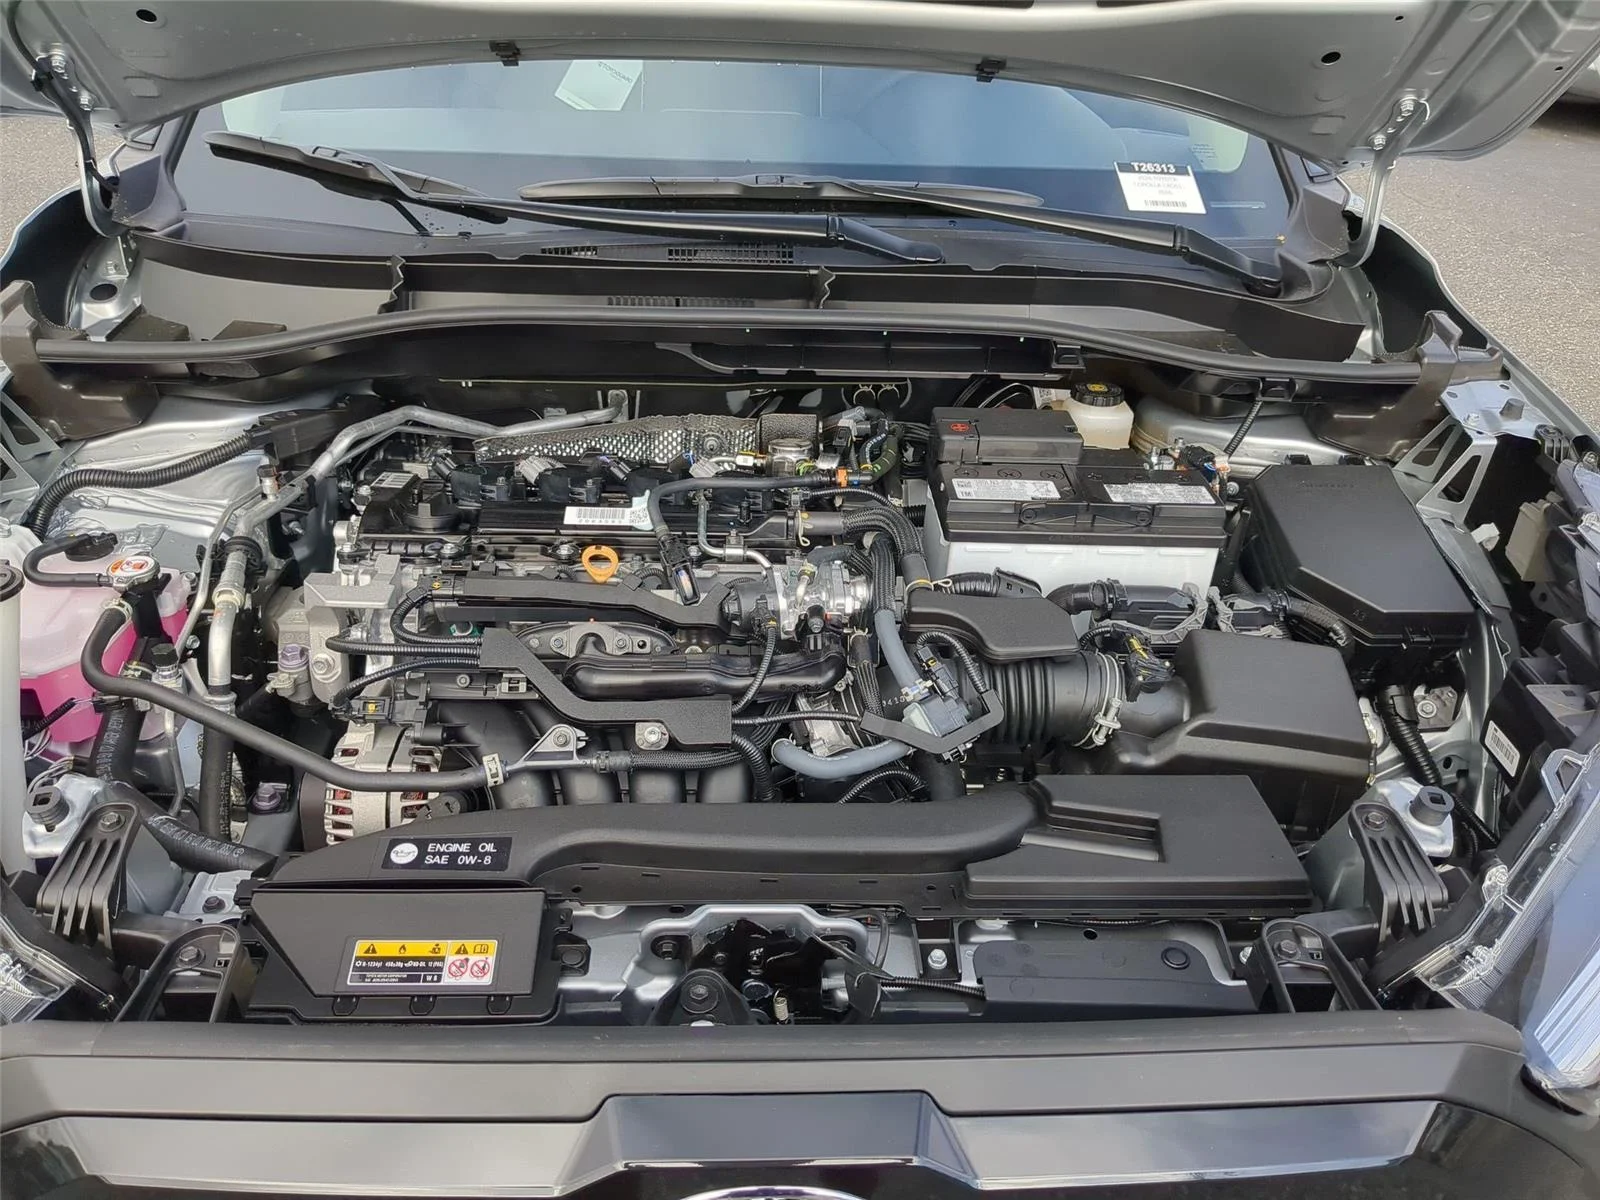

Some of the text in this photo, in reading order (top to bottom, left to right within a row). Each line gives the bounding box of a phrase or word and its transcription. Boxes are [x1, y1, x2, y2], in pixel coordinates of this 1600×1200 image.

[1131, 162, 1176, 173] T26313
[427, 843, 497, 853] ENGINE OIL
[424, 855, 492, 865] SAE 0W-8
